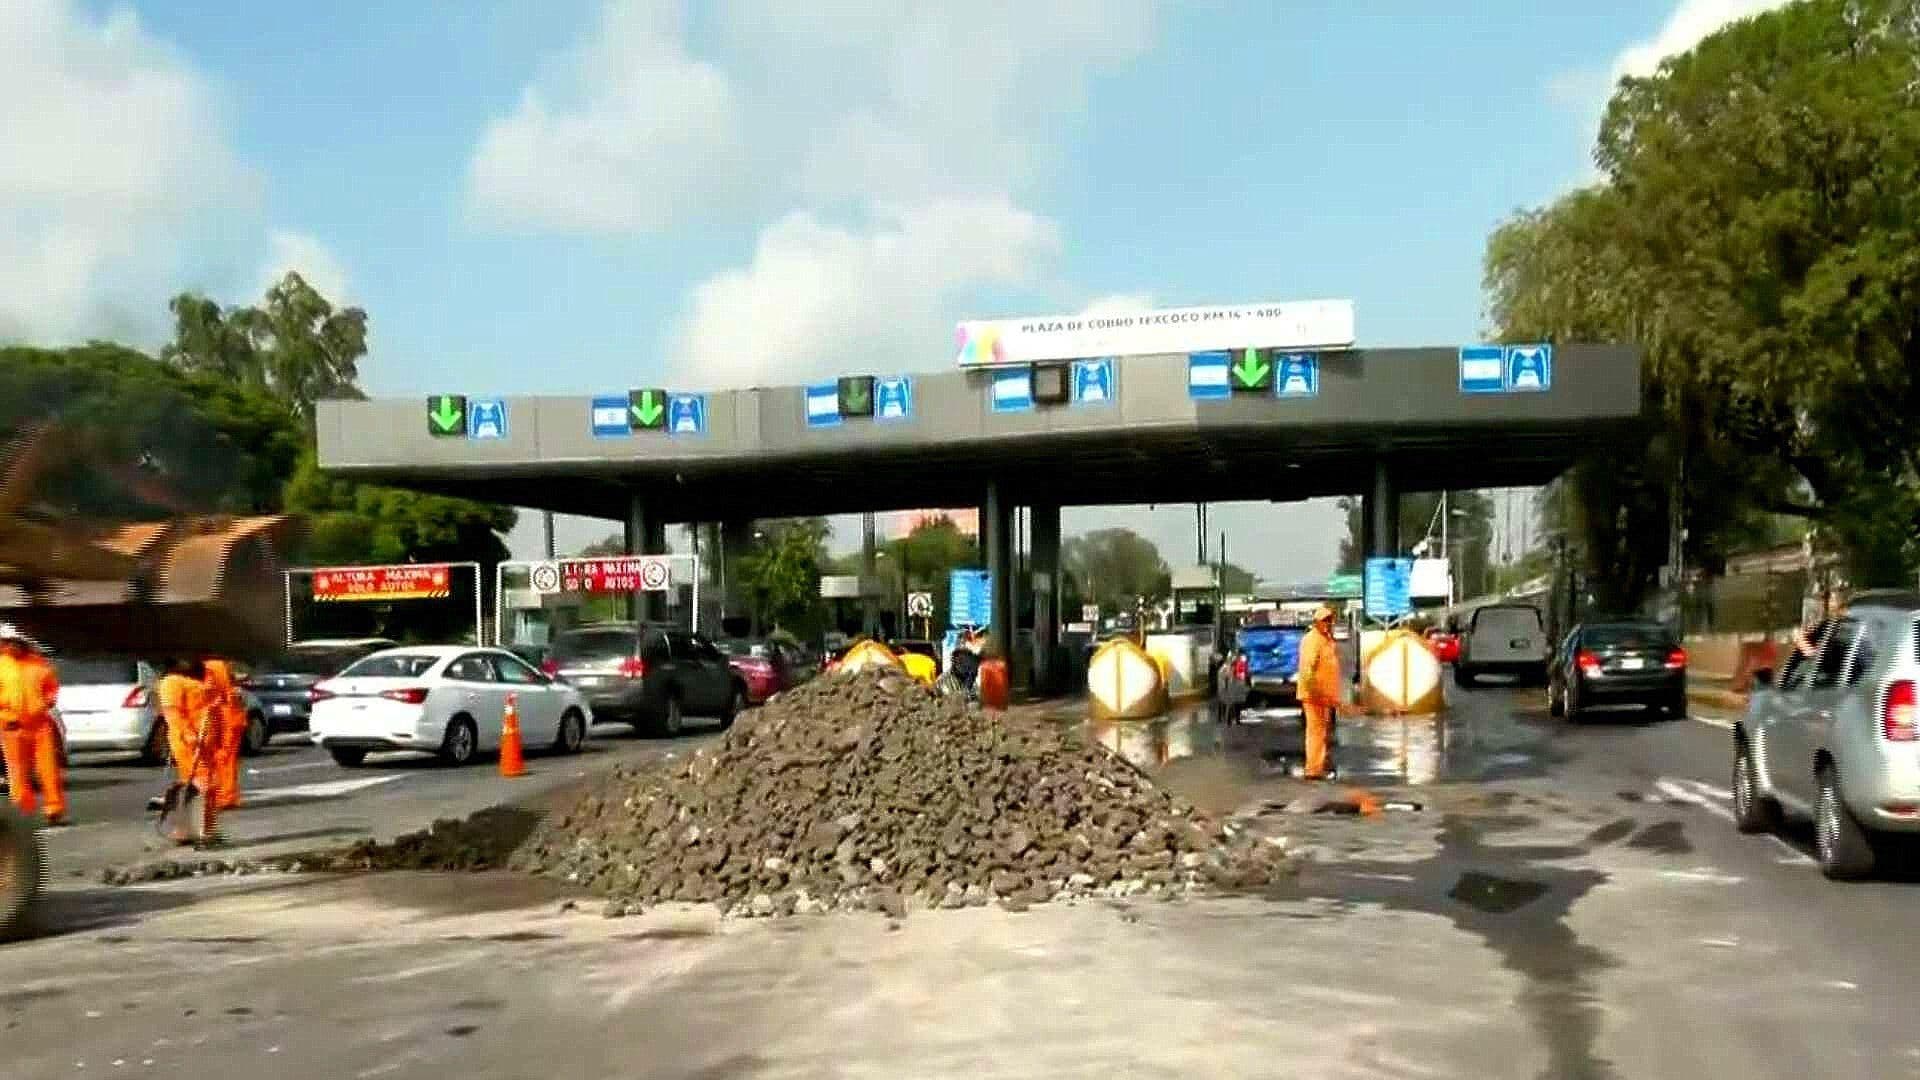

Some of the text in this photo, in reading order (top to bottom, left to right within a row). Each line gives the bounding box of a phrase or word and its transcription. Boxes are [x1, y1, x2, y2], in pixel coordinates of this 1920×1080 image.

[1021, 321, 1064, 333] PLAZA
[1067, 321, 1082, 331] DE
[1088, 318, 1133, 329] COBRO
[1139, 313, 1199, 326] TEXCOCO
[331, 571, 376, 584] ALTURA
[565, 577, 593, 591] SOO
[380, 580, 416, 592] AUTOS
